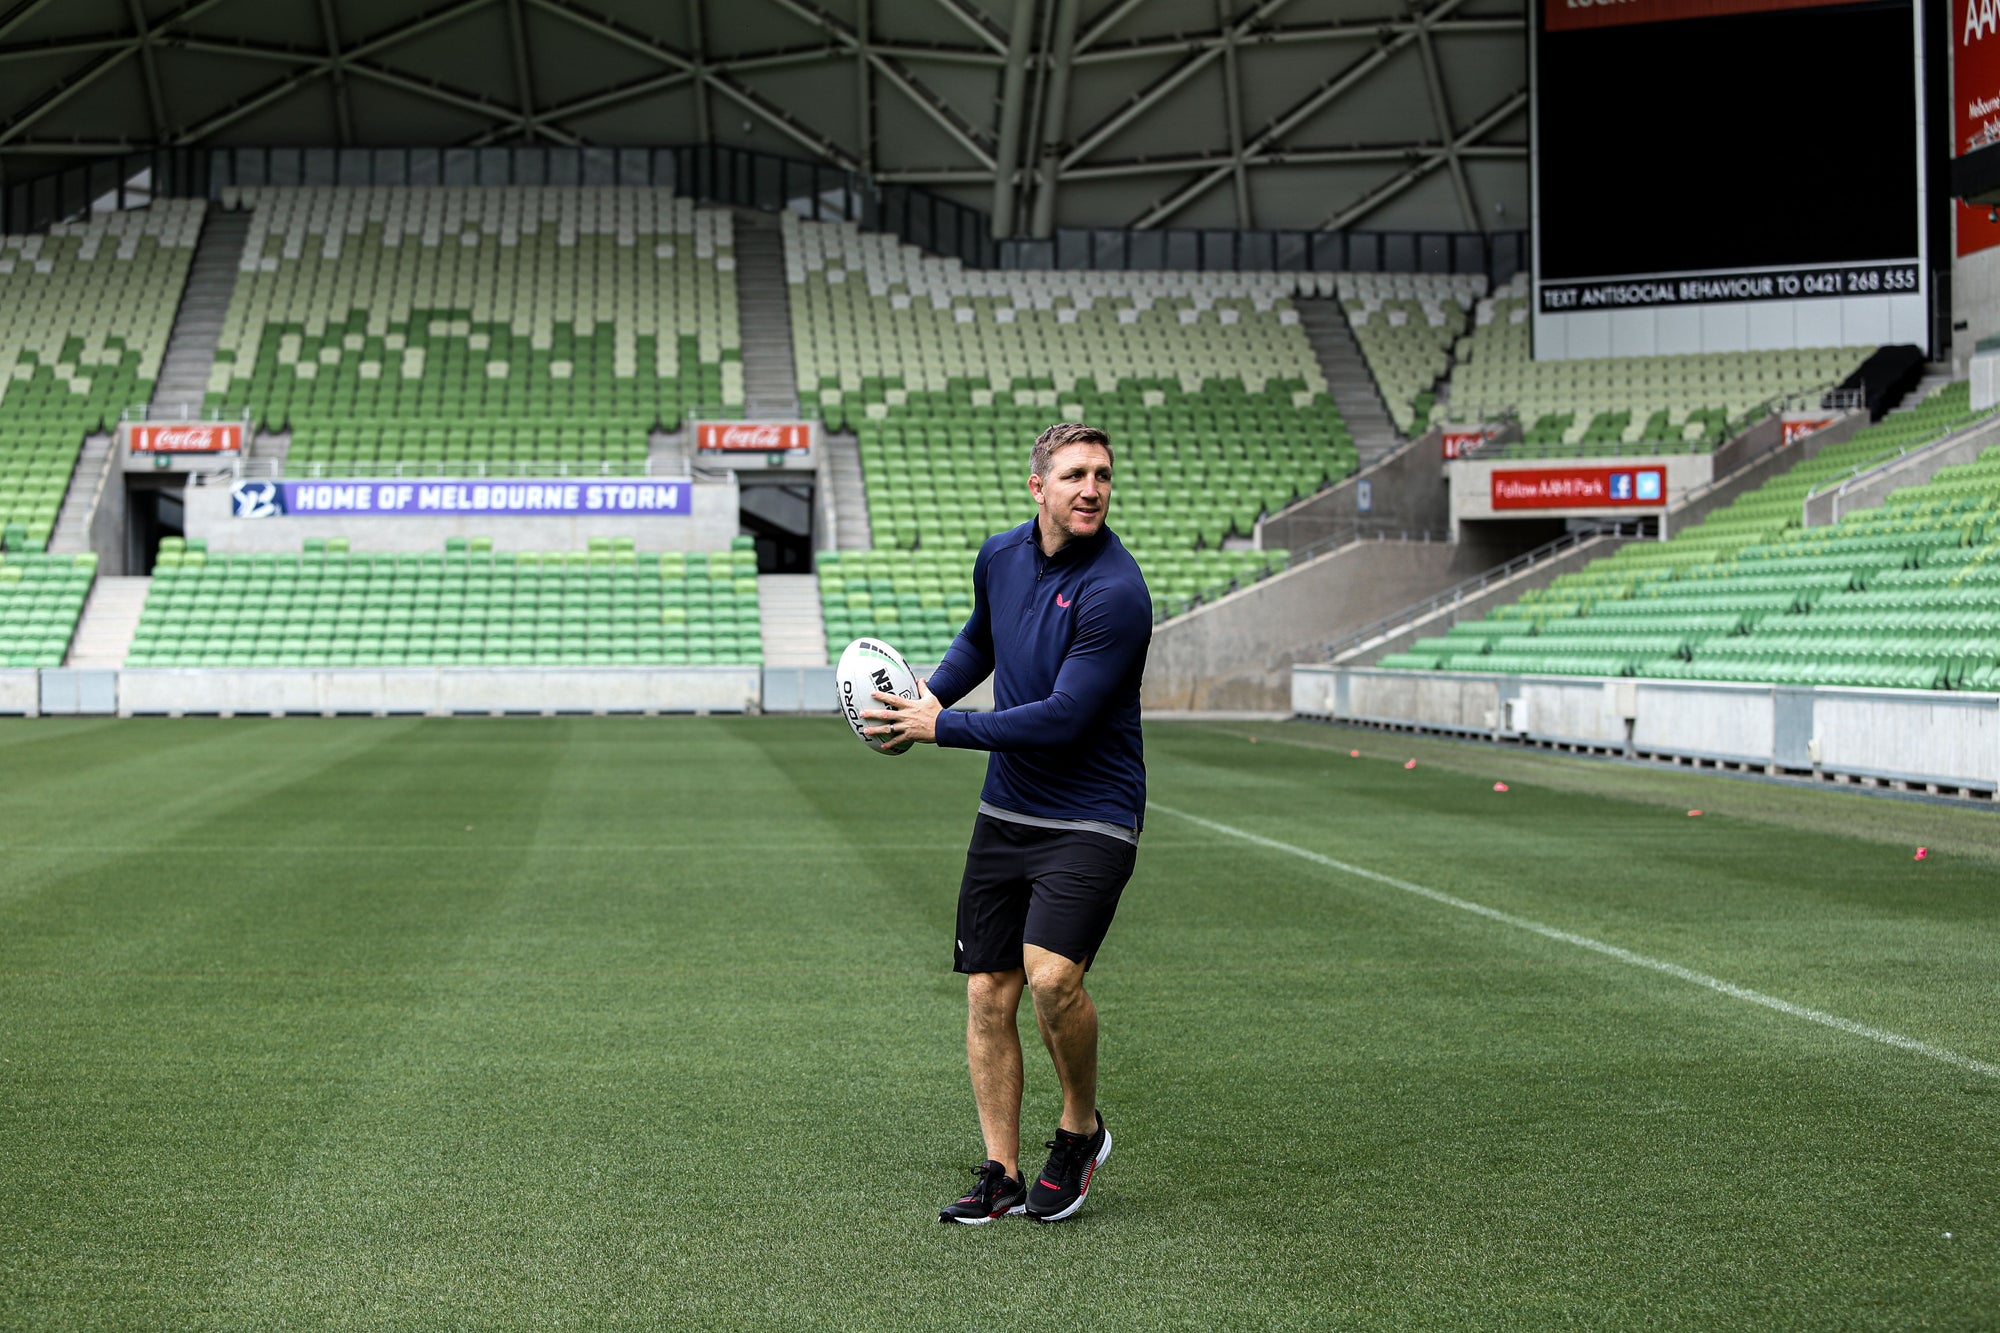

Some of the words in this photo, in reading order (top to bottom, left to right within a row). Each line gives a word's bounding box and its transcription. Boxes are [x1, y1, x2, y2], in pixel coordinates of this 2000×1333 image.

[1544, 288, 1578, 308] TEXT
[1581, 283, 1676, 305] ANTISOCIAL
[1679, 277, 1773, 300] BEHAVIOUR
[1776, 275, 1800, 295] TO
[1803, 272, 1842, 294] 0421
[1848, 270, 1880, 292] 268
[1883, 269, 1915, 290] 555
[296, 485, 372, 510] HOME
[377, 485, 414, 510] OF
[418, 485, 580, 510] MELBOURNE
[585, 485, 678, 510] STORM
[1495, 480, 1537, 498] Follow
[1573, 478, 1604, 497] Park
